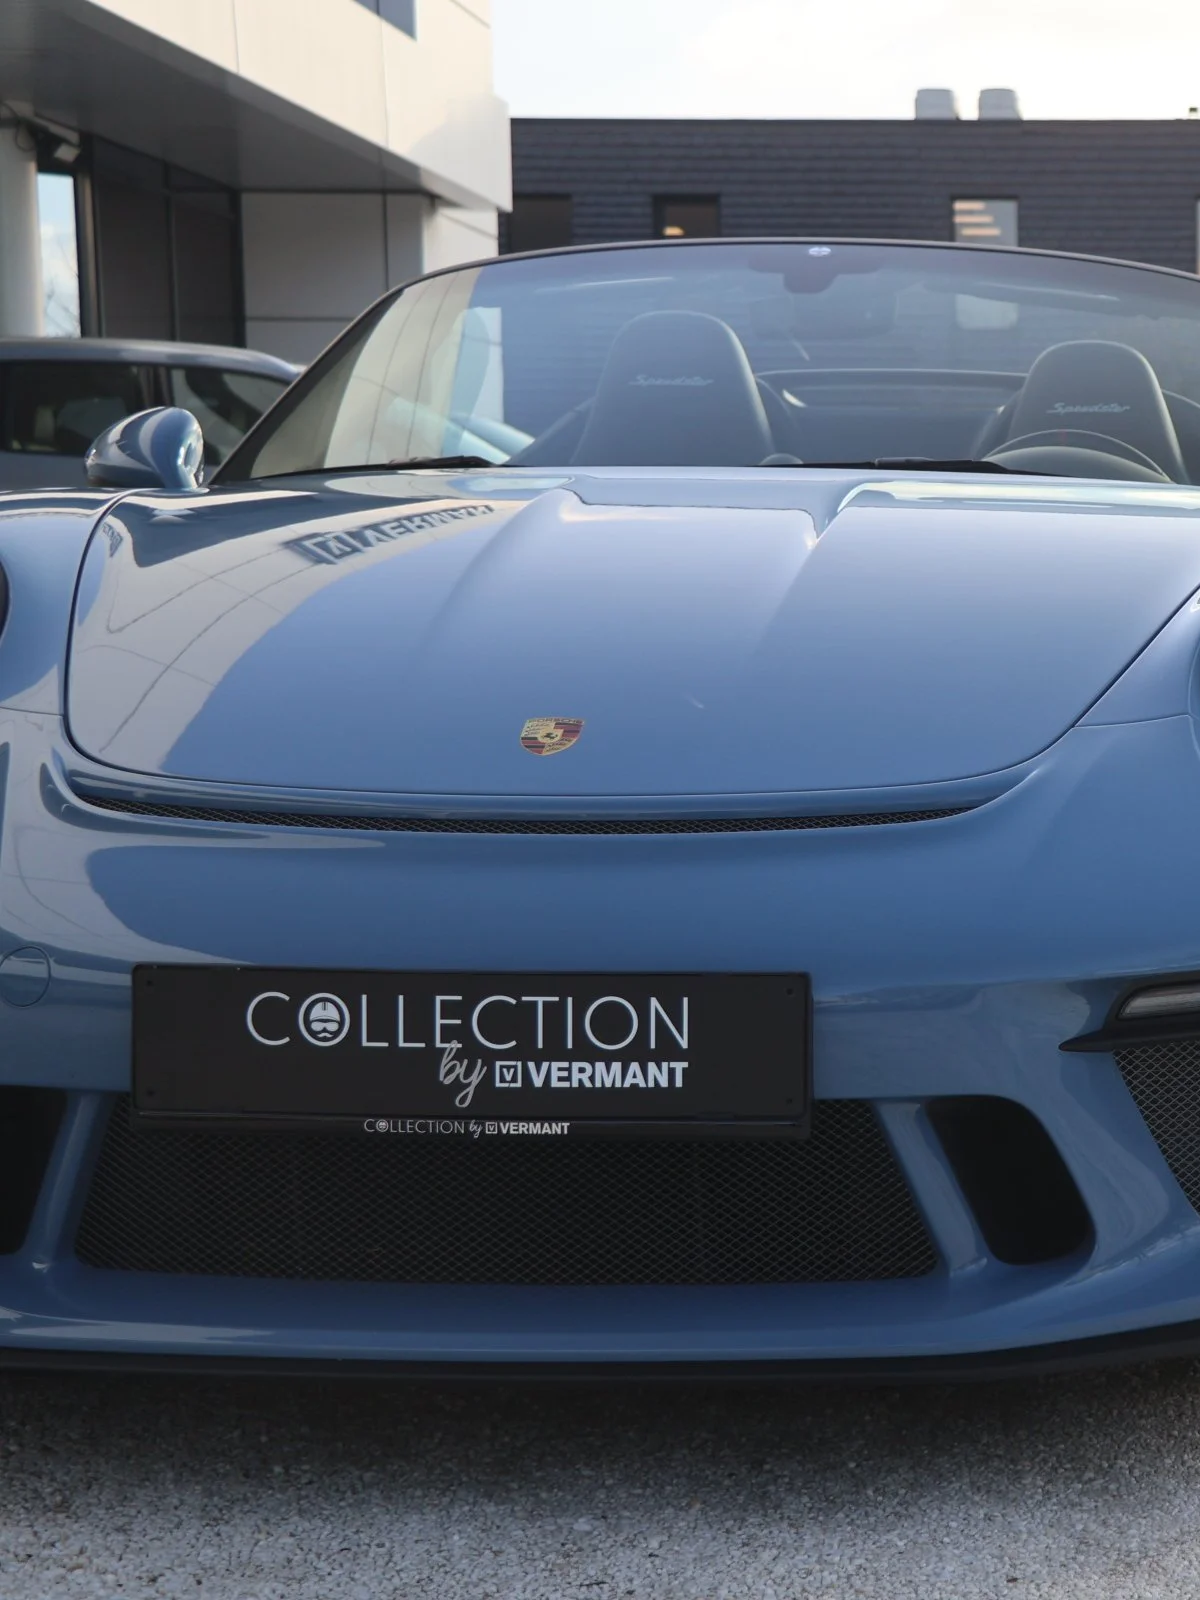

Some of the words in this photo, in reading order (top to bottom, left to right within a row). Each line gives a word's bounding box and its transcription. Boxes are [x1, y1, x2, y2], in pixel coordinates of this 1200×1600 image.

[246, 991, 689, 1050] COLLECTION
[438, 1040, 487, 1107] by
[528, 1061, 689, 1088] VERMANT
[364, 1118, 465, 1134] COLLECTION
[469, 1119, 483, 1138] by
[500, 1122, 570, 1135] VERMANT
